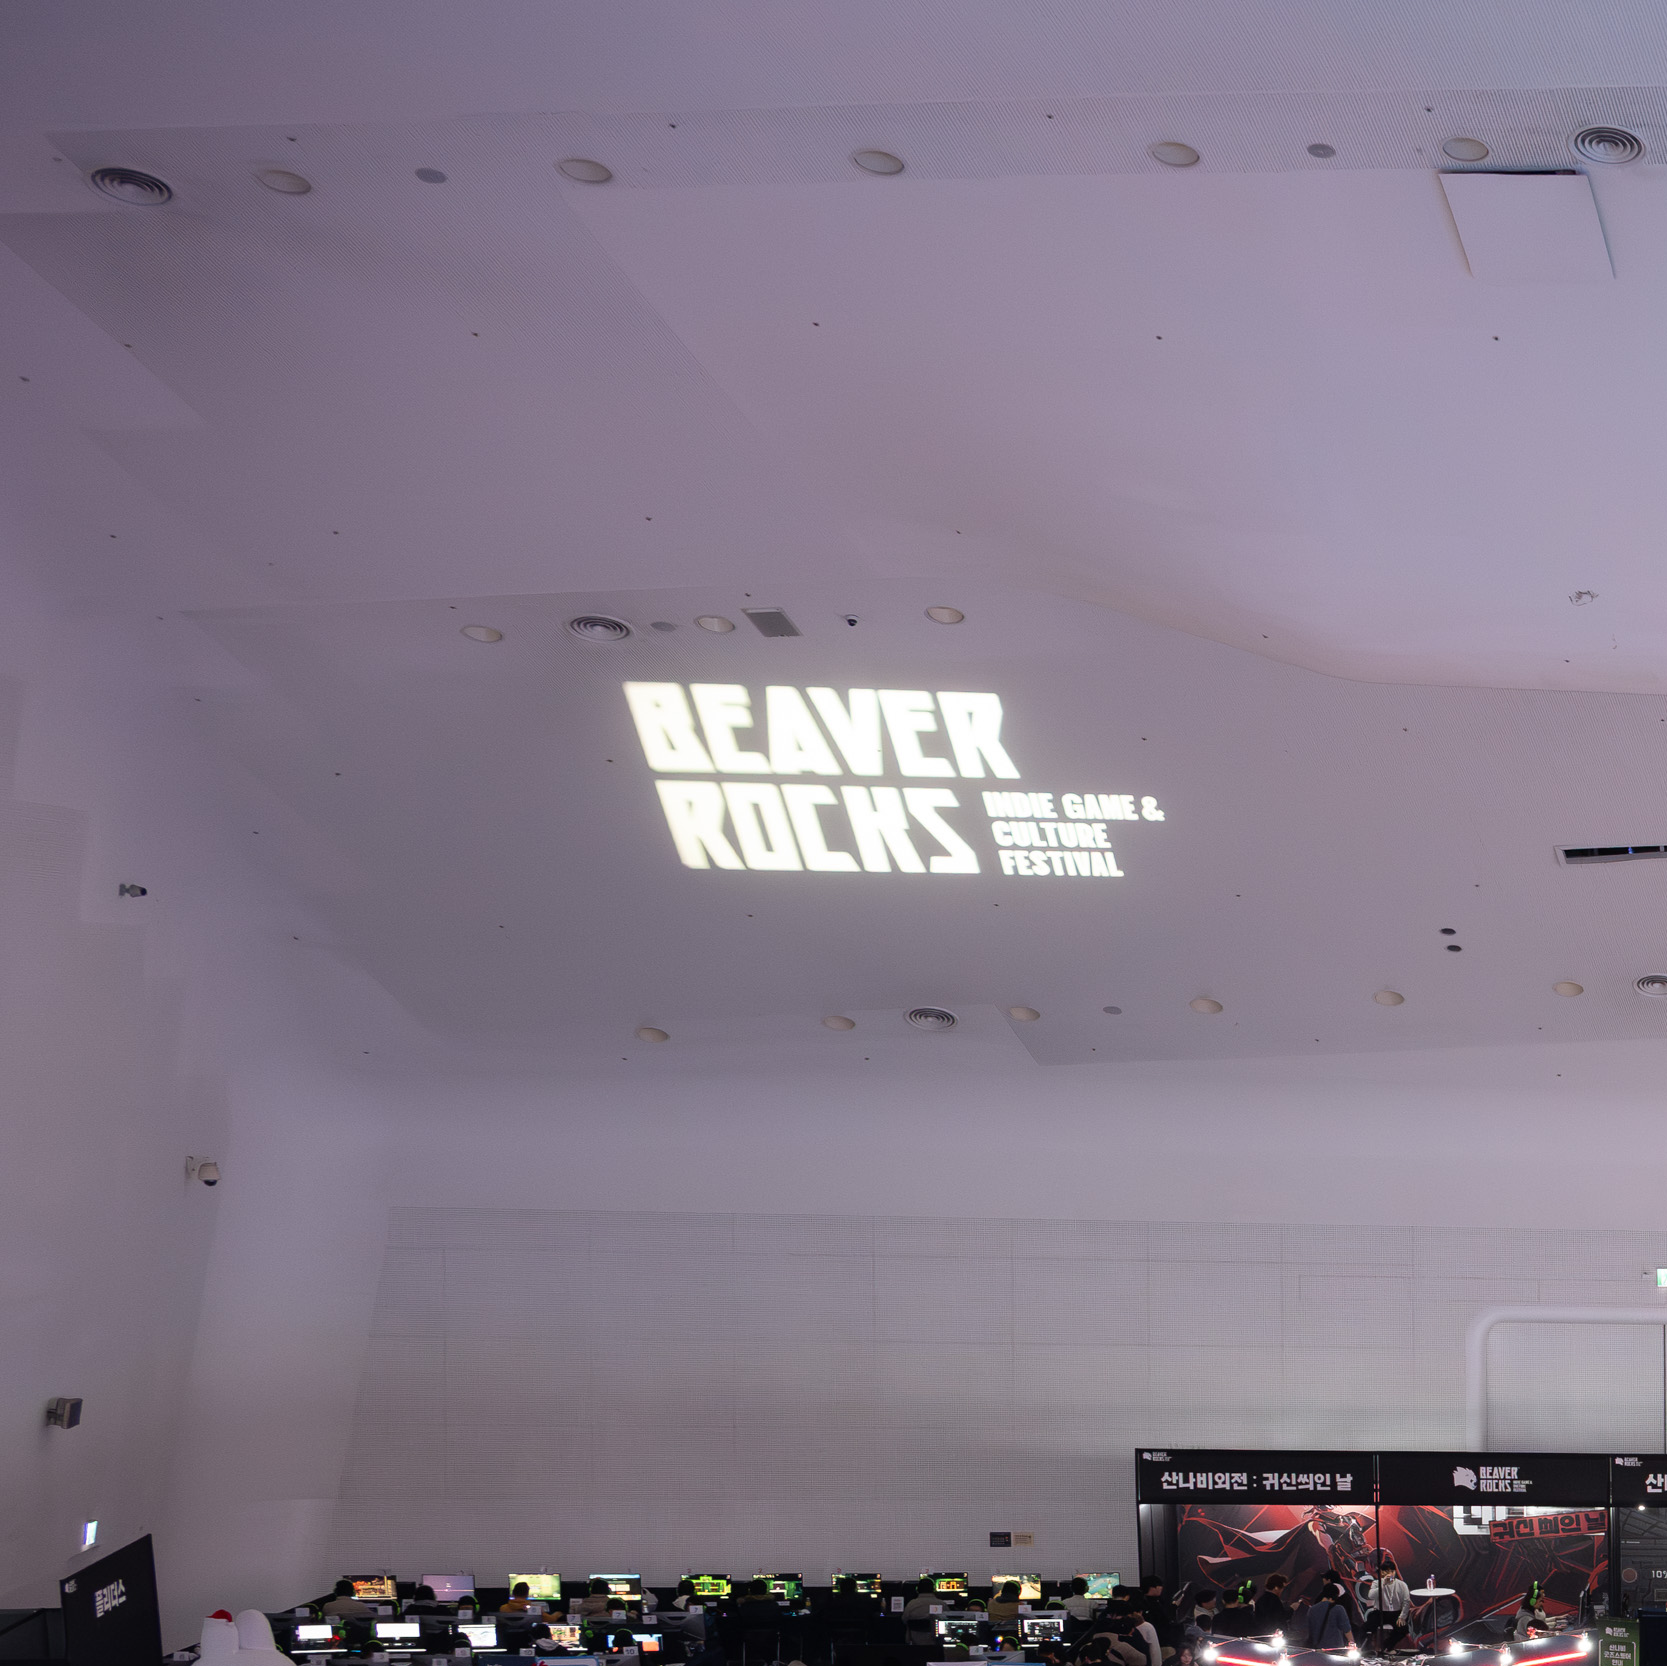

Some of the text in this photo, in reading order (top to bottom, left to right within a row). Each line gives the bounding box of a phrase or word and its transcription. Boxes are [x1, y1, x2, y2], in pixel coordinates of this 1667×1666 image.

[622, 681, 1021, 779] BEAVER
[982, 791, 1165, 821] INDIE GAME &
[655, 779, 981, 873] ROCKS
[991, 822, 1112, 849] CULTURE
[998, 850, 1124, 877] FESTIVAL
[1161, 1472, 1247, 1490] 산나비외전
[1336, 1473, 1352, 1490] 날
